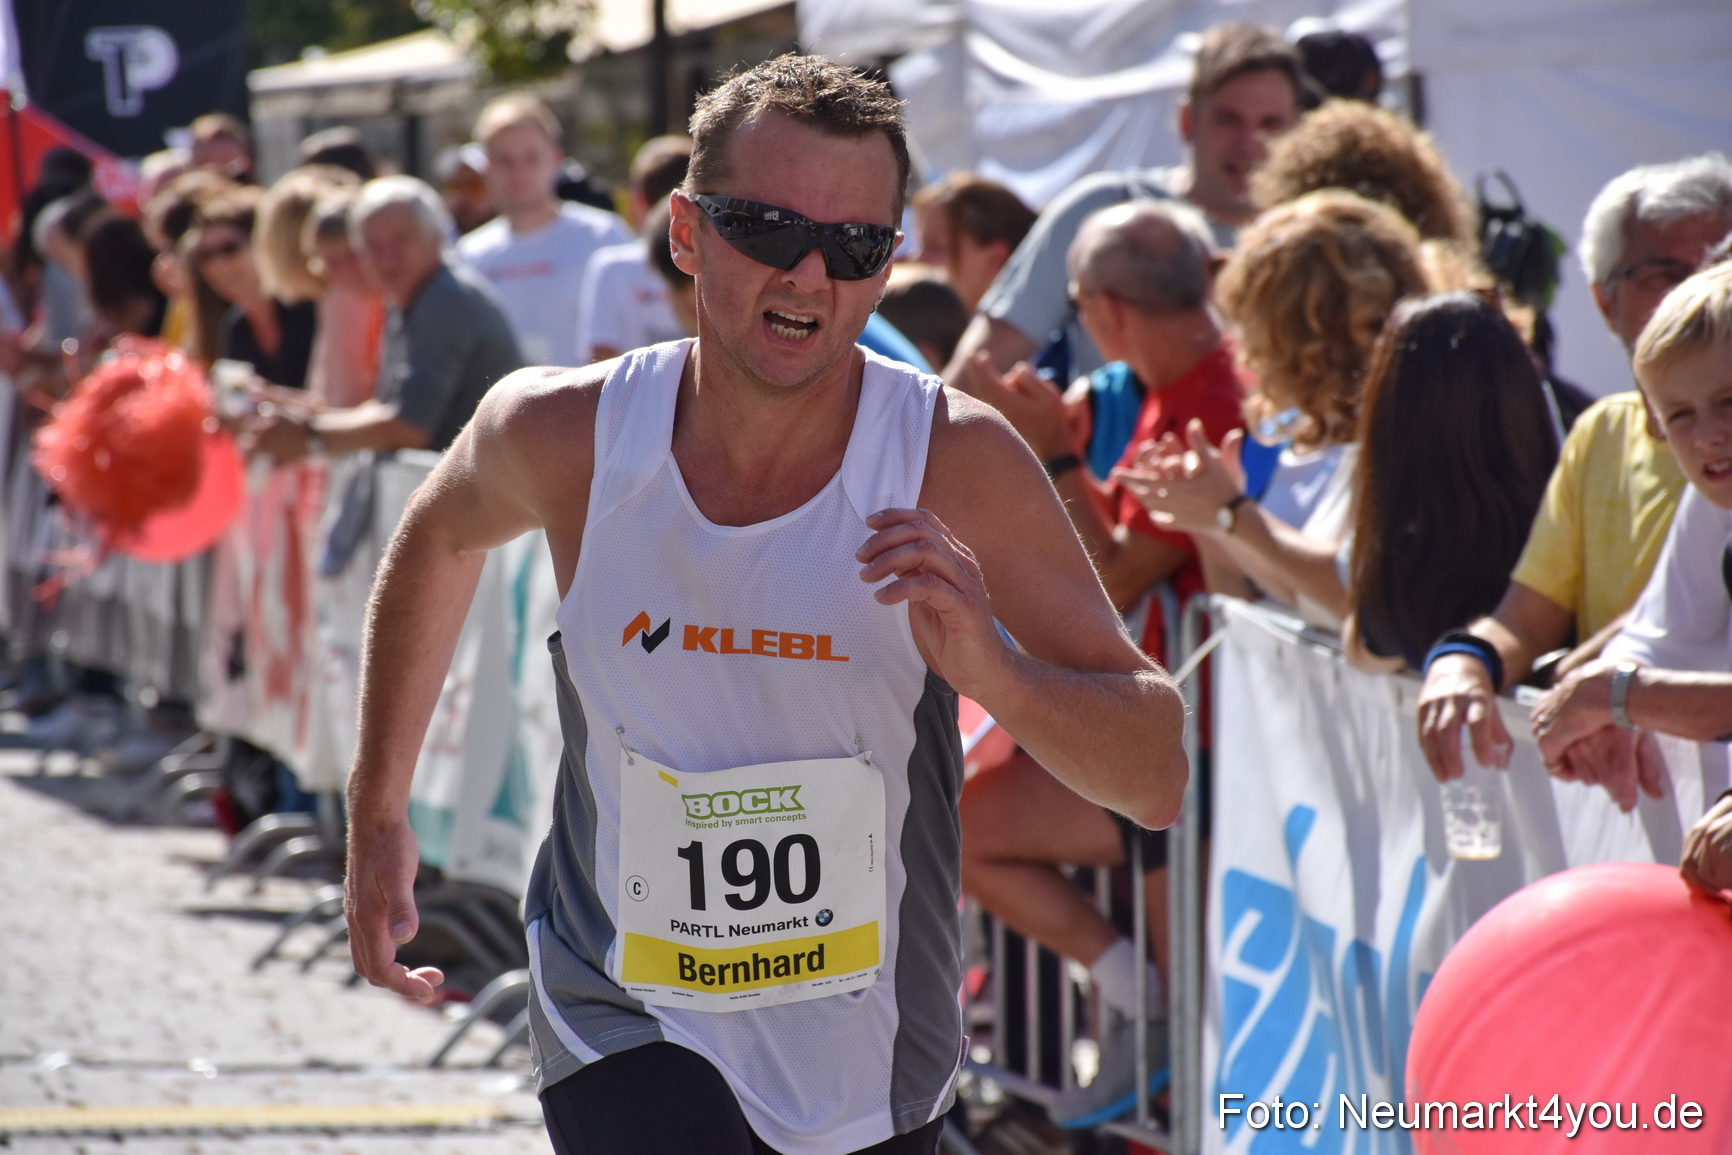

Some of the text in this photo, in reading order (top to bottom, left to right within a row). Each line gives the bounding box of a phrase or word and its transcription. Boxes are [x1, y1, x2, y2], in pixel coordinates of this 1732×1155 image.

[683, 625, 849, 661] KLEBL
[682, 785, 805, 820] BOCK
[685, 813, 807, 829] inspired by smart concepts
[633, 881, 641, 895] C
[677, 834, 821, 911] 190
[670, 916, 809, 938] PARTL Neumarkt
[678, 943, 825, 986] Bernhard
